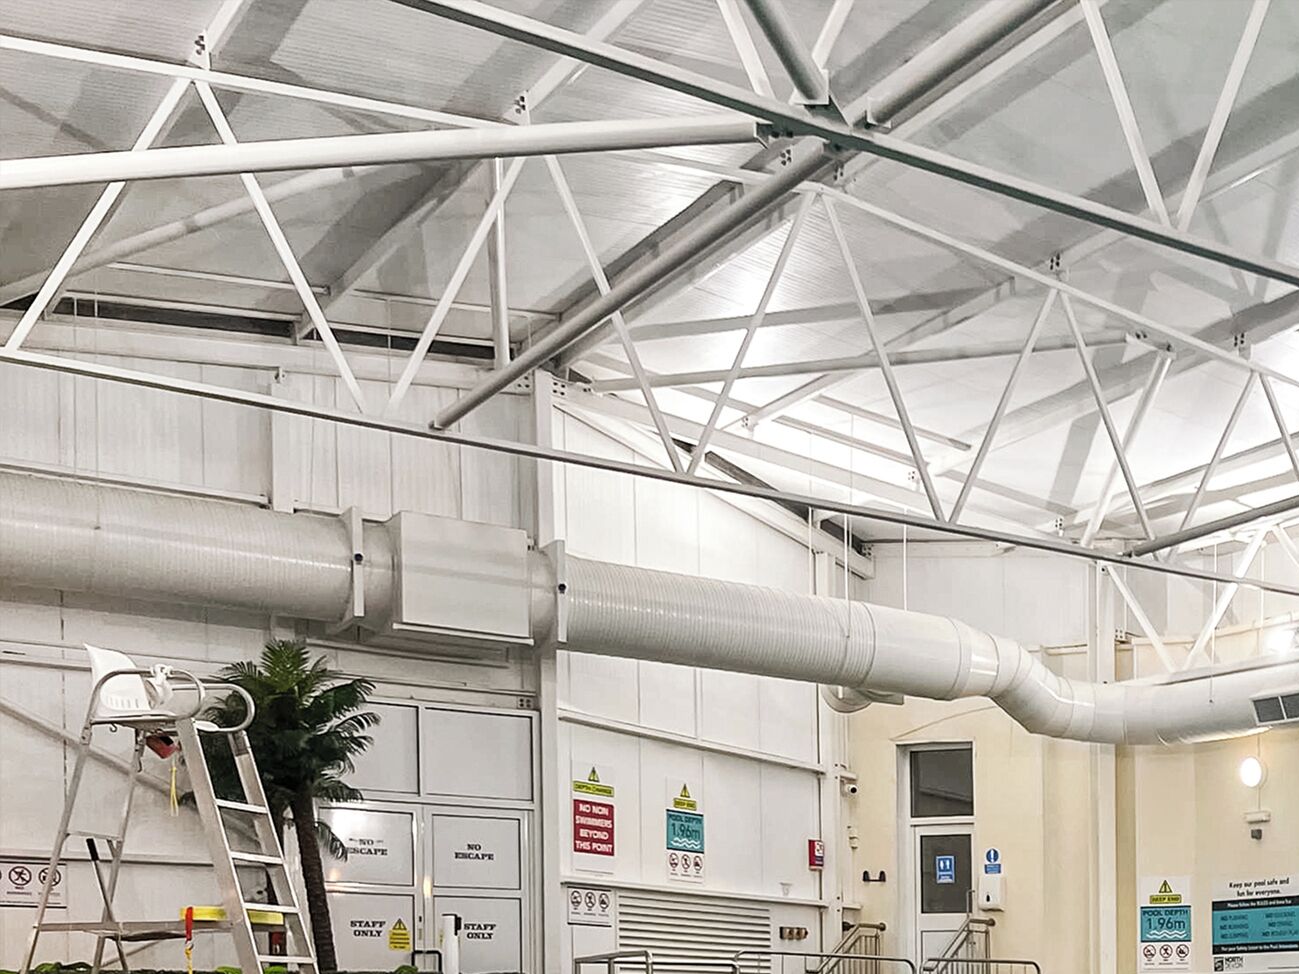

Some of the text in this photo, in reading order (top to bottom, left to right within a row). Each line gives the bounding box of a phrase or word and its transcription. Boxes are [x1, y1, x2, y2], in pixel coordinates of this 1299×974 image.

[579, 803, 608, 816] NO NON
[575, 816, 612, 828] SWIMMERS
[579, 829, 609, 840] BEYOND
[672, 823, 700, 839] 1.96m
[467, 843, 481, 851] NO
[575, 841, 612, 853] THIS POINT
[454, 852, 494, 861] ESCAPE
[1254, 880, 1265, 888] pool
[1267, 878, 1278, 886] safe
[350, 920, 386, 929] STAFF
[463, 923, 496, 931] STAFF
[1147, 917, 1185, 930] 1.96m
[353, 930, 383, 938] ONLY
[466, 932, 494, 940] ONLY
